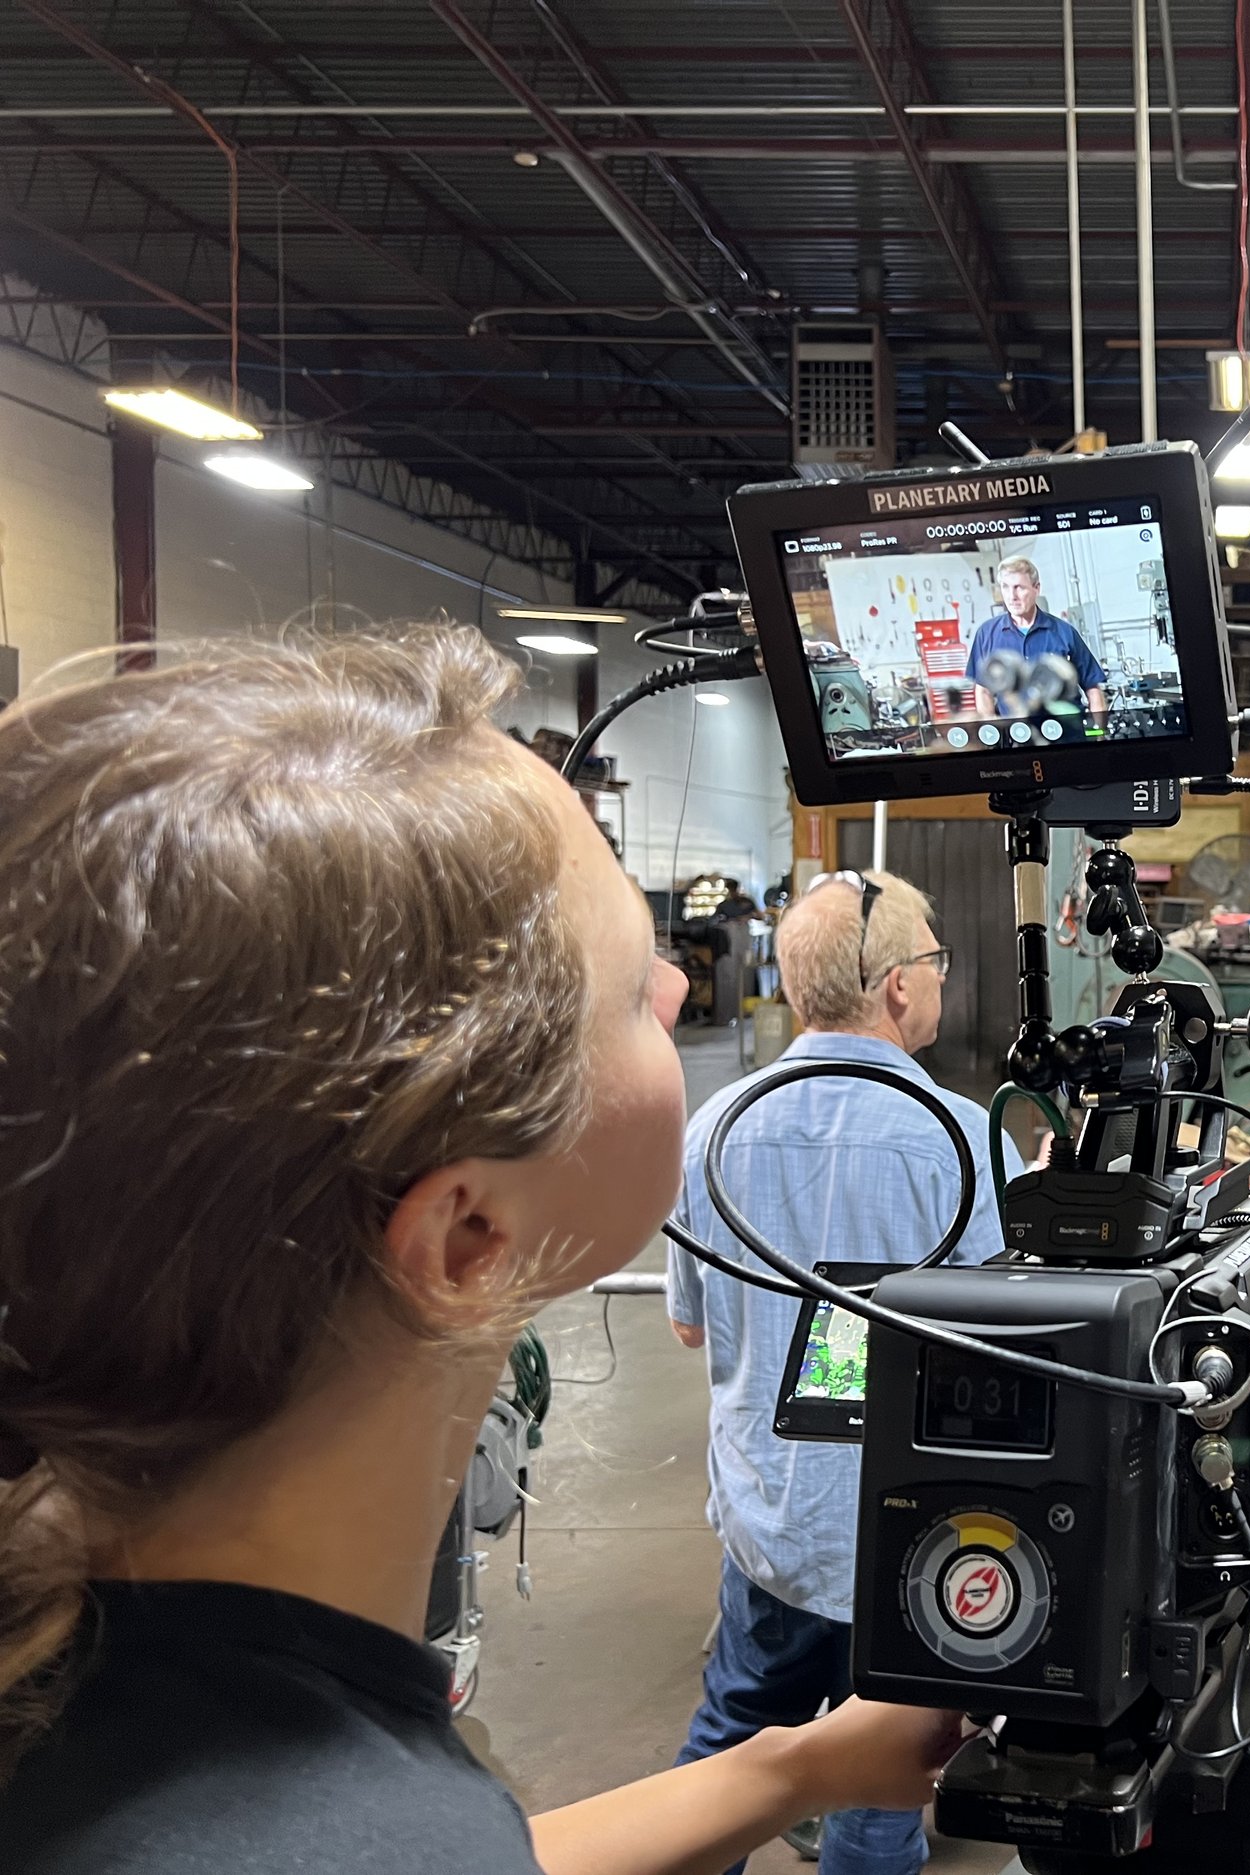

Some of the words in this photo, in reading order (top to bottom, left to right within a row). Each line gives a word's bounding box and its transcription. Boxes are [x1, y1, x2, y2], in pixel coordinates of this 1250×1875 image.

[873, 482, 981, 512] PLANETARY
[986, 474, 1050, 500] MEDIA
[1088, 518, 1101, 526] No
[1101, 515, 1118, 525] card
[926, 519, 1007, 539] 00:00:00:00
[1008, 525, 1023, 534] T/C
[1023, 524, 1038, 532] Run
